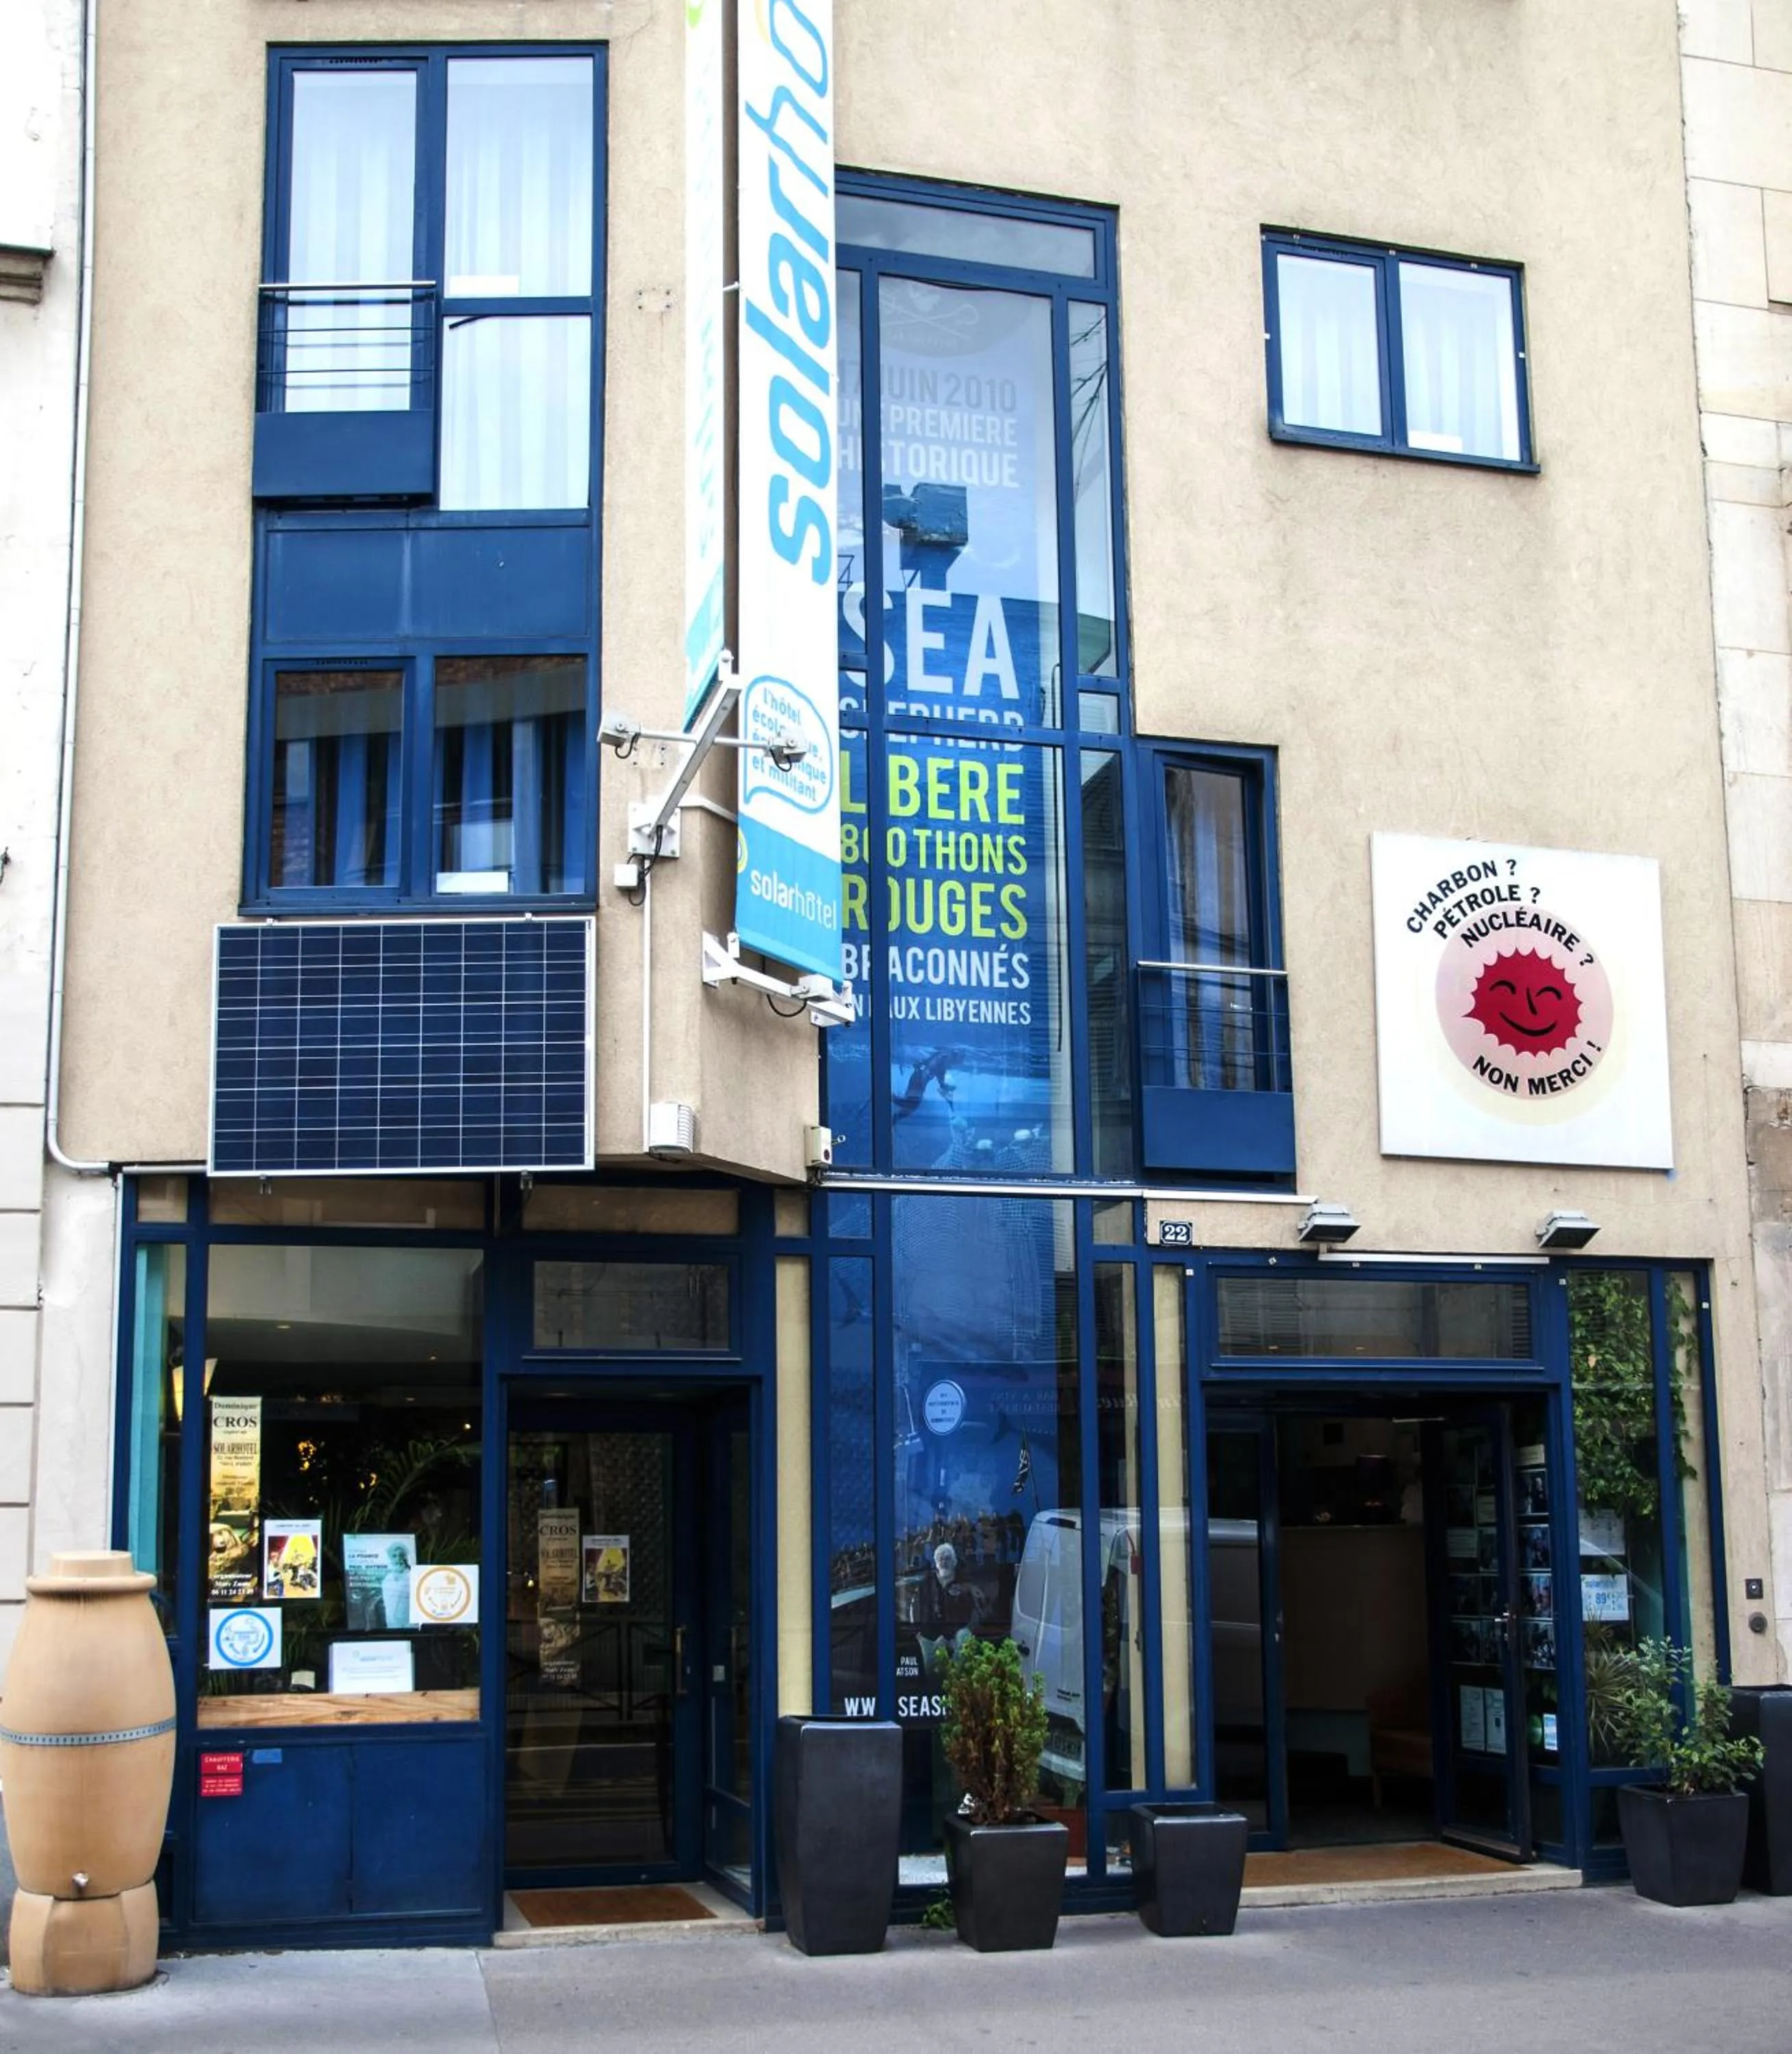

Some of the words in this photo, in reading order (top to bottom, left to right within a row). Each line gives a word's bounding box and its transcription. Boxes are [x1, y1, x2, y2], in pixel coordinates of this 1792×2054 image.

[944, 372, 1016, 414] 2010
[890, 404, 1018, 446] PREMIERE
[839, 434, 1020, 489] HITORIQUE
[843, 581, 1019, 699] SEA
[763, 687, 802, 726] l'hôtel
[753, 755, 765, 773] et
[769, 765, 817, 802] militant
[840, 750, 1026, 825] LBERE
[841, 824, 907, 868] 80
[912, 829, 1027, 876] THONS
[1406, 859, 1498, 935] CHARBON
[1505, 859, 1517, 876] ?
[1432, 884, 1522, 940] PÉTROLE
[1530, 887, 1541, 904] ?
[1459, 906, 1581, 952] NUCLÉAIRE
[1578, 953, 1594, 967] ?
[925, 998, 1032, 1025] LIBYENNES
[1472, 1055, 1520, 1093] NON
[1527, 1052, 1593, 1096] MERCI
[1586, 1039, 1602, 1052] !
[1164, 1225, 1187, 1241] 22
[213, 1416, 257, 1428] CROS
[539, 1524, 577, 1536] CROS
[896, 1668, 918, 1676] ATSON
[901, 1656, 917, 1665] PAUL
